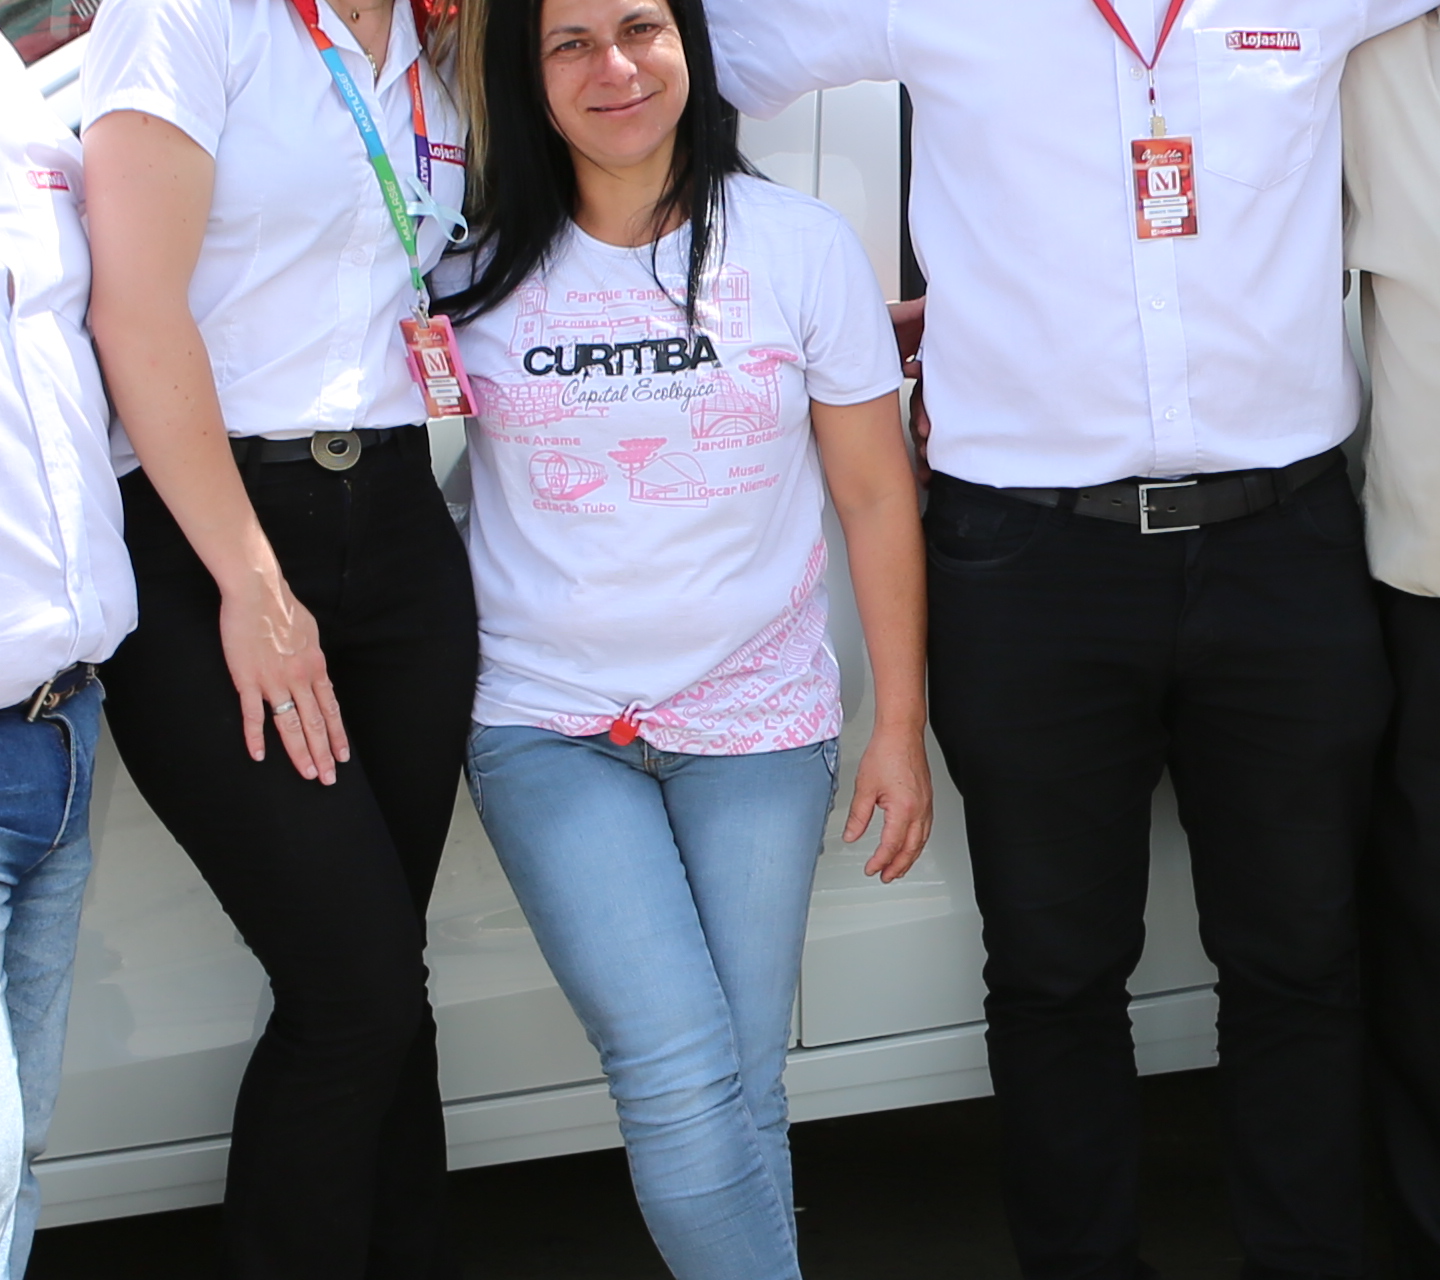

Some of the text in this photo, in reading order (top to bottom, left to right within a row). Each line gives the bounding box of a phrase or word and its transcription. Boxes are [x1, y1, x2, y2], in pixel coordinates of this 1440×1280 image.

[1241, 32, 1299, 51] LojasMM
[565, 288, 623, 305] Parque
[523, 335, 723, 377] CURITIBA
[561, 377, 718, 413] Capital Ecológica
[532, 434, 582, 447] Arame
[692, 436, 743, 453] Jardim
[728, 463, 766, 479] Museu
[697, 485, 738, 498] Oscar
[532, 498, 617, 514] Estação Tubo
